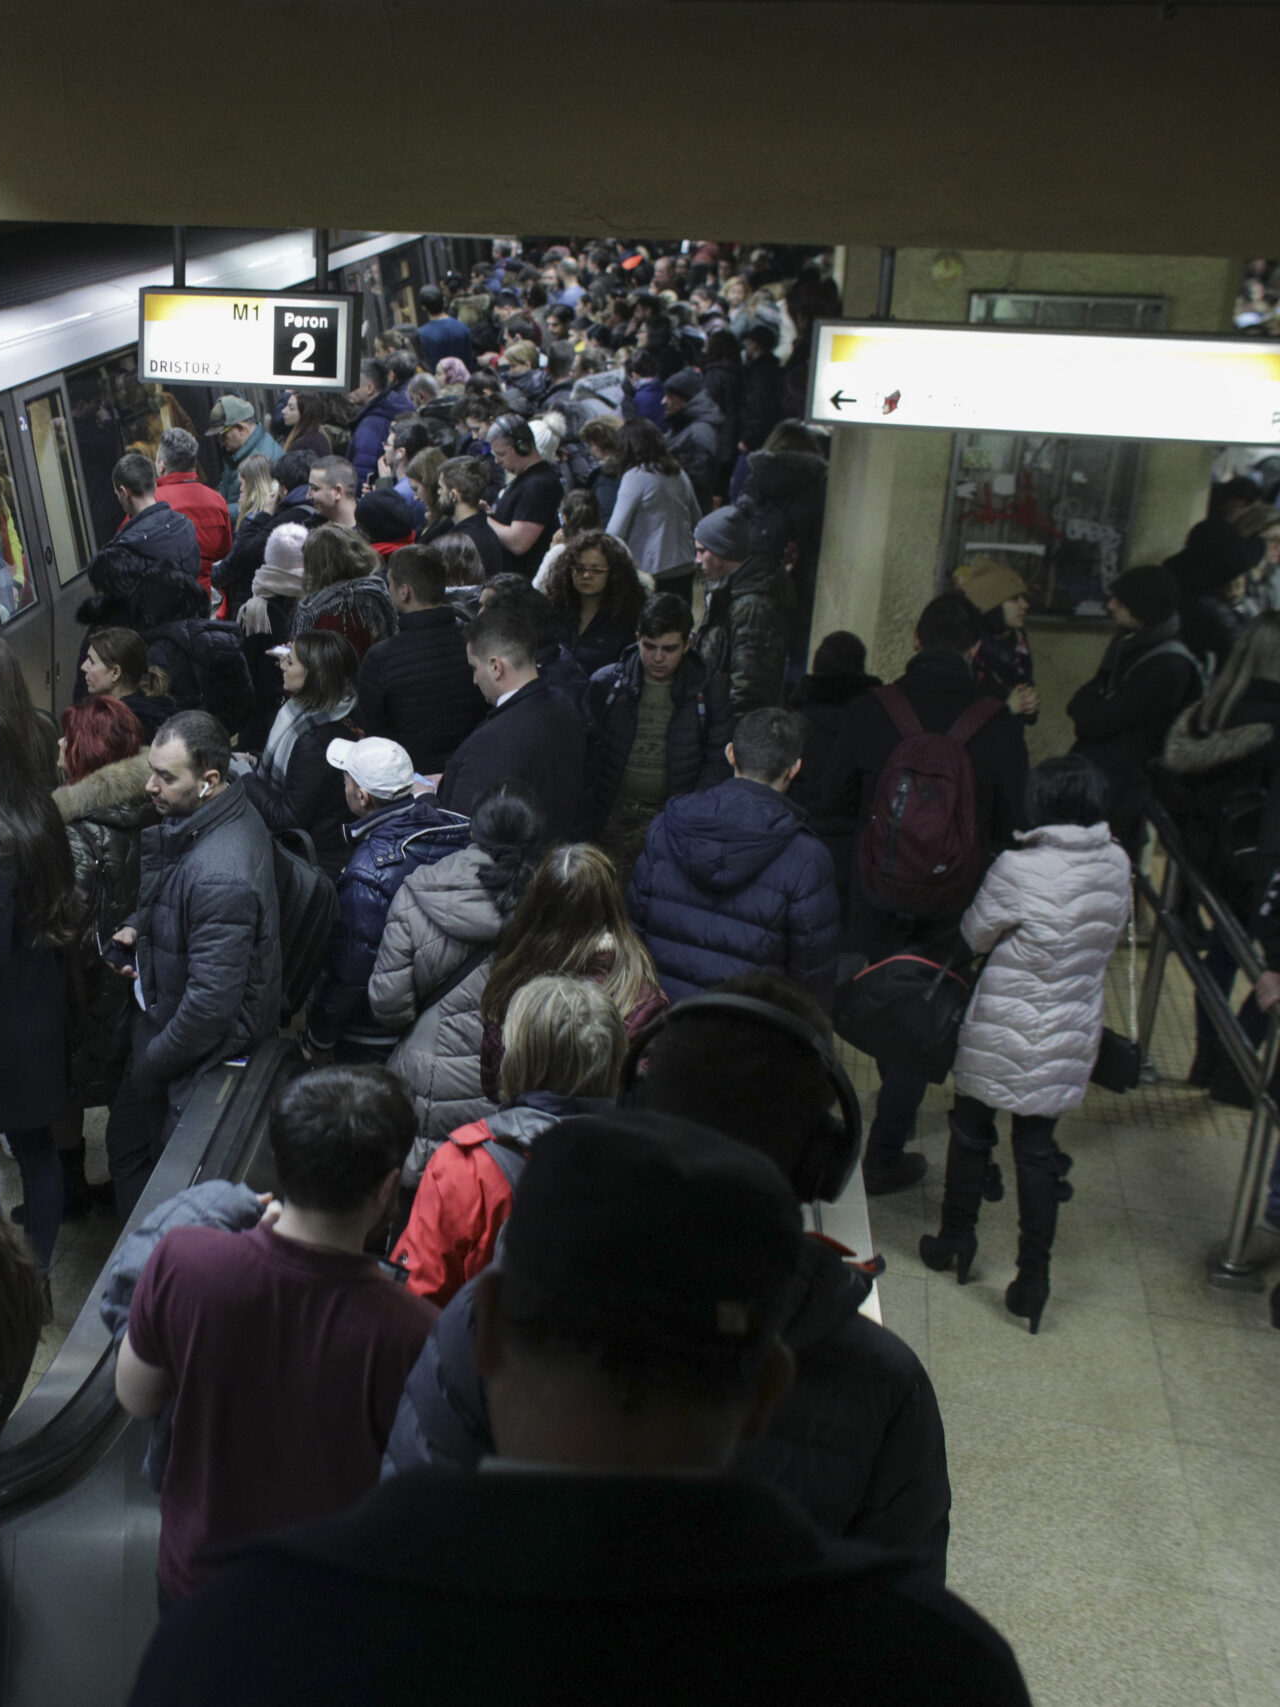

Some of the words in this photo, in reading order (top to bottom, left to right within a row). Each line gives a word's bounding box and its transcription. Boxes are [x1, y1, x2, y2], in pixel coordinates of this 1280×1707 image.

[233, 304, 260, 321] M1
[284, 312, 328, 328] Peron
[291, 332, 315, 371] 2
[150, 359, 210, 375] DRISTOR
[214, 363, 222, 375] 2
